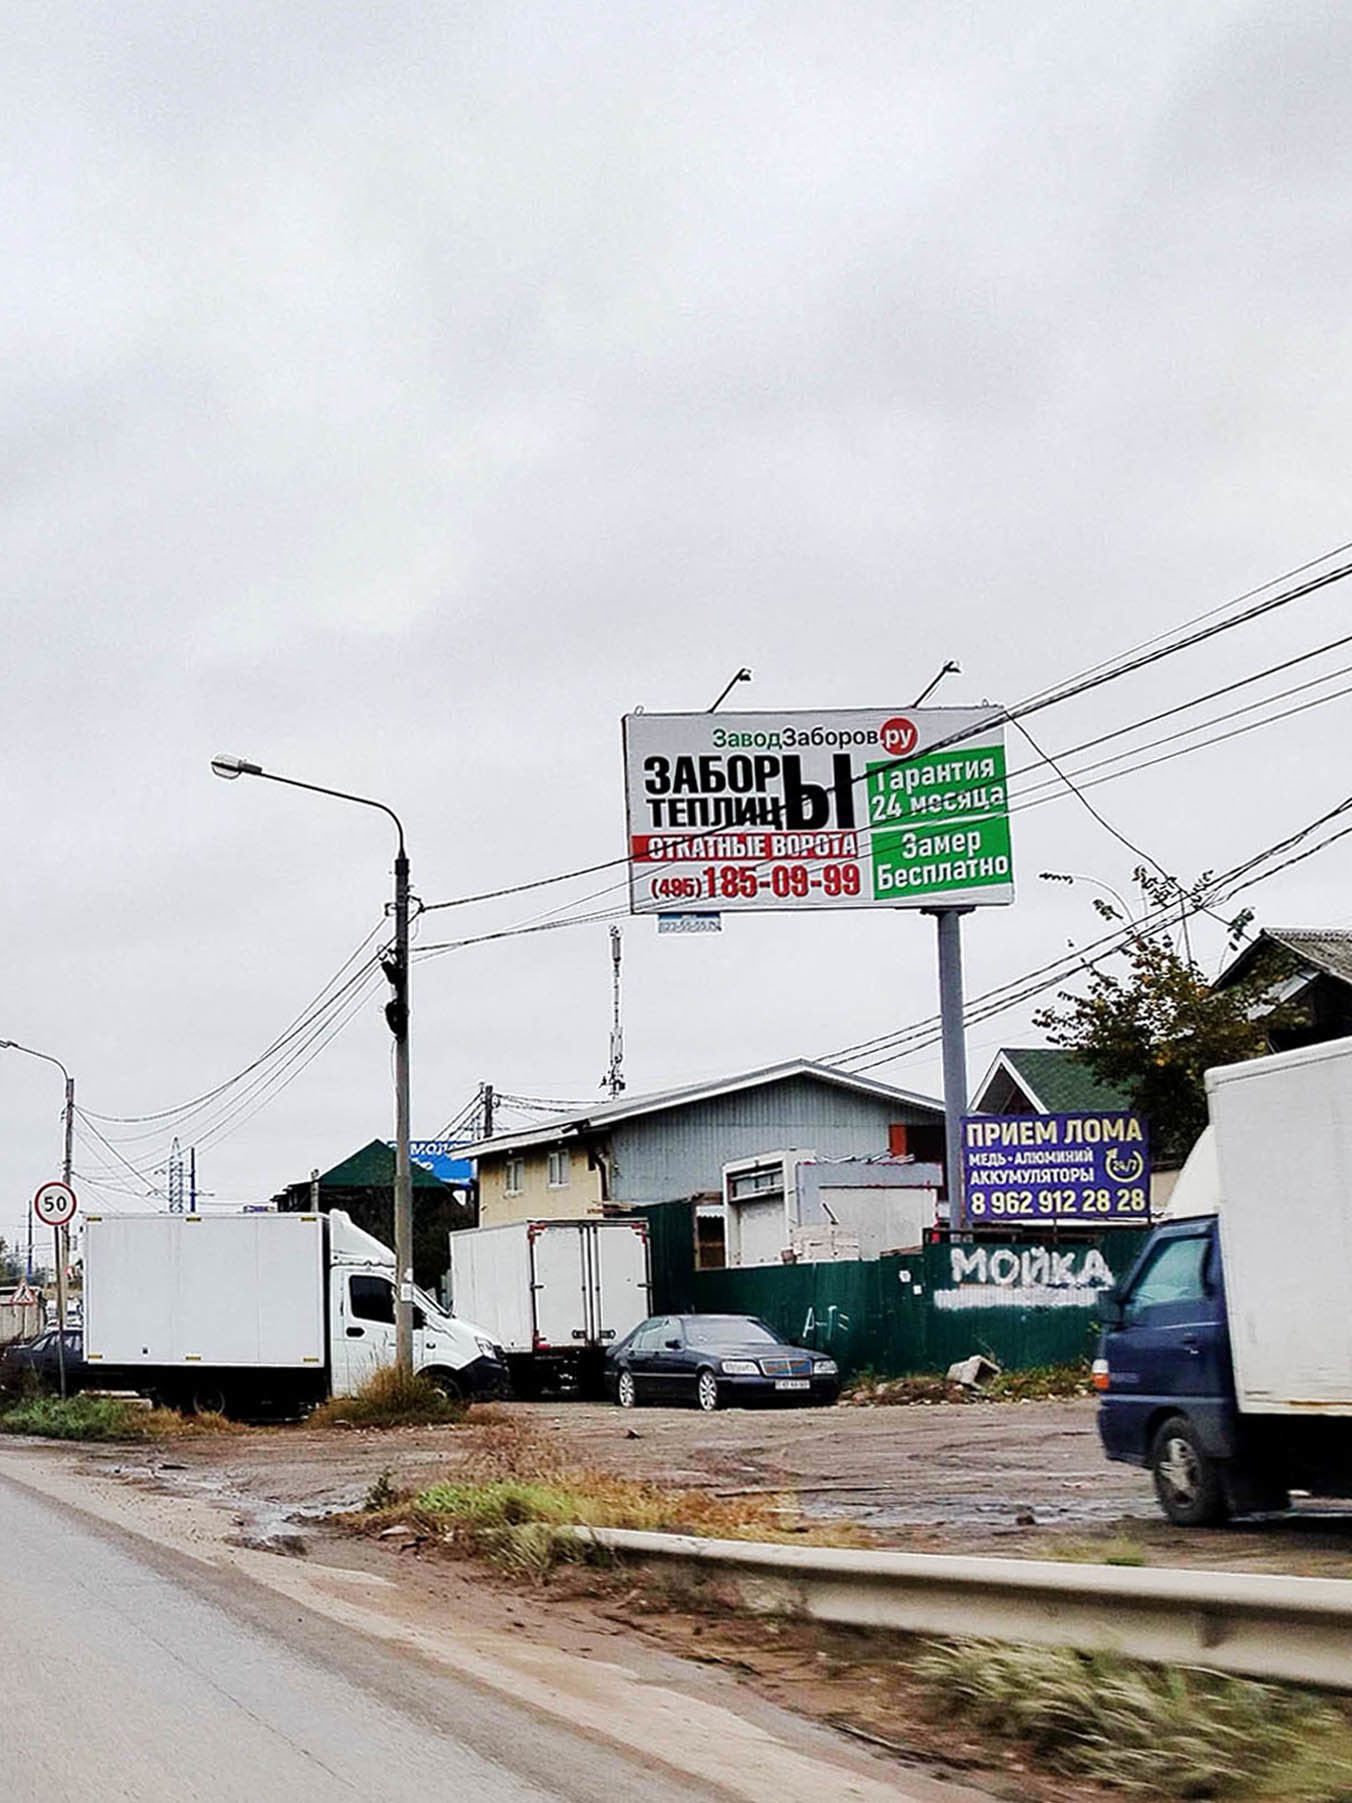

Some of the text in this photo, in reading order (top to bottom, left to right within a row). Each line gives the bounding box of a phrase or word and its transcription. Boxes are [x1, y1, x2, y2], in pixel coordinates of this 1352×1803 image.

[877, 758, 995, 794] Гарантия
[871, 786, 1005, 821] 24 месяца
[649, 833, 857, 860] ОТКАТНЫЕ ВОРОТА
[901, 831, 981, 859] Замер
[703, 863, 861, 898] 185-09-99
[877, 856, 1009, 891] Бесплатно
[966, 1117, 1143, 1147] ПРИЕМ ЛОМА
[970, 1167, 1095, 1186] АККУМУЛЯТОРЫ
[43, 1195, 67, 1213] 50
[971, 1188, 1146, 1215] 8 962 912 28 28
[950, 1246, 1116, 1290] МОЙКА
